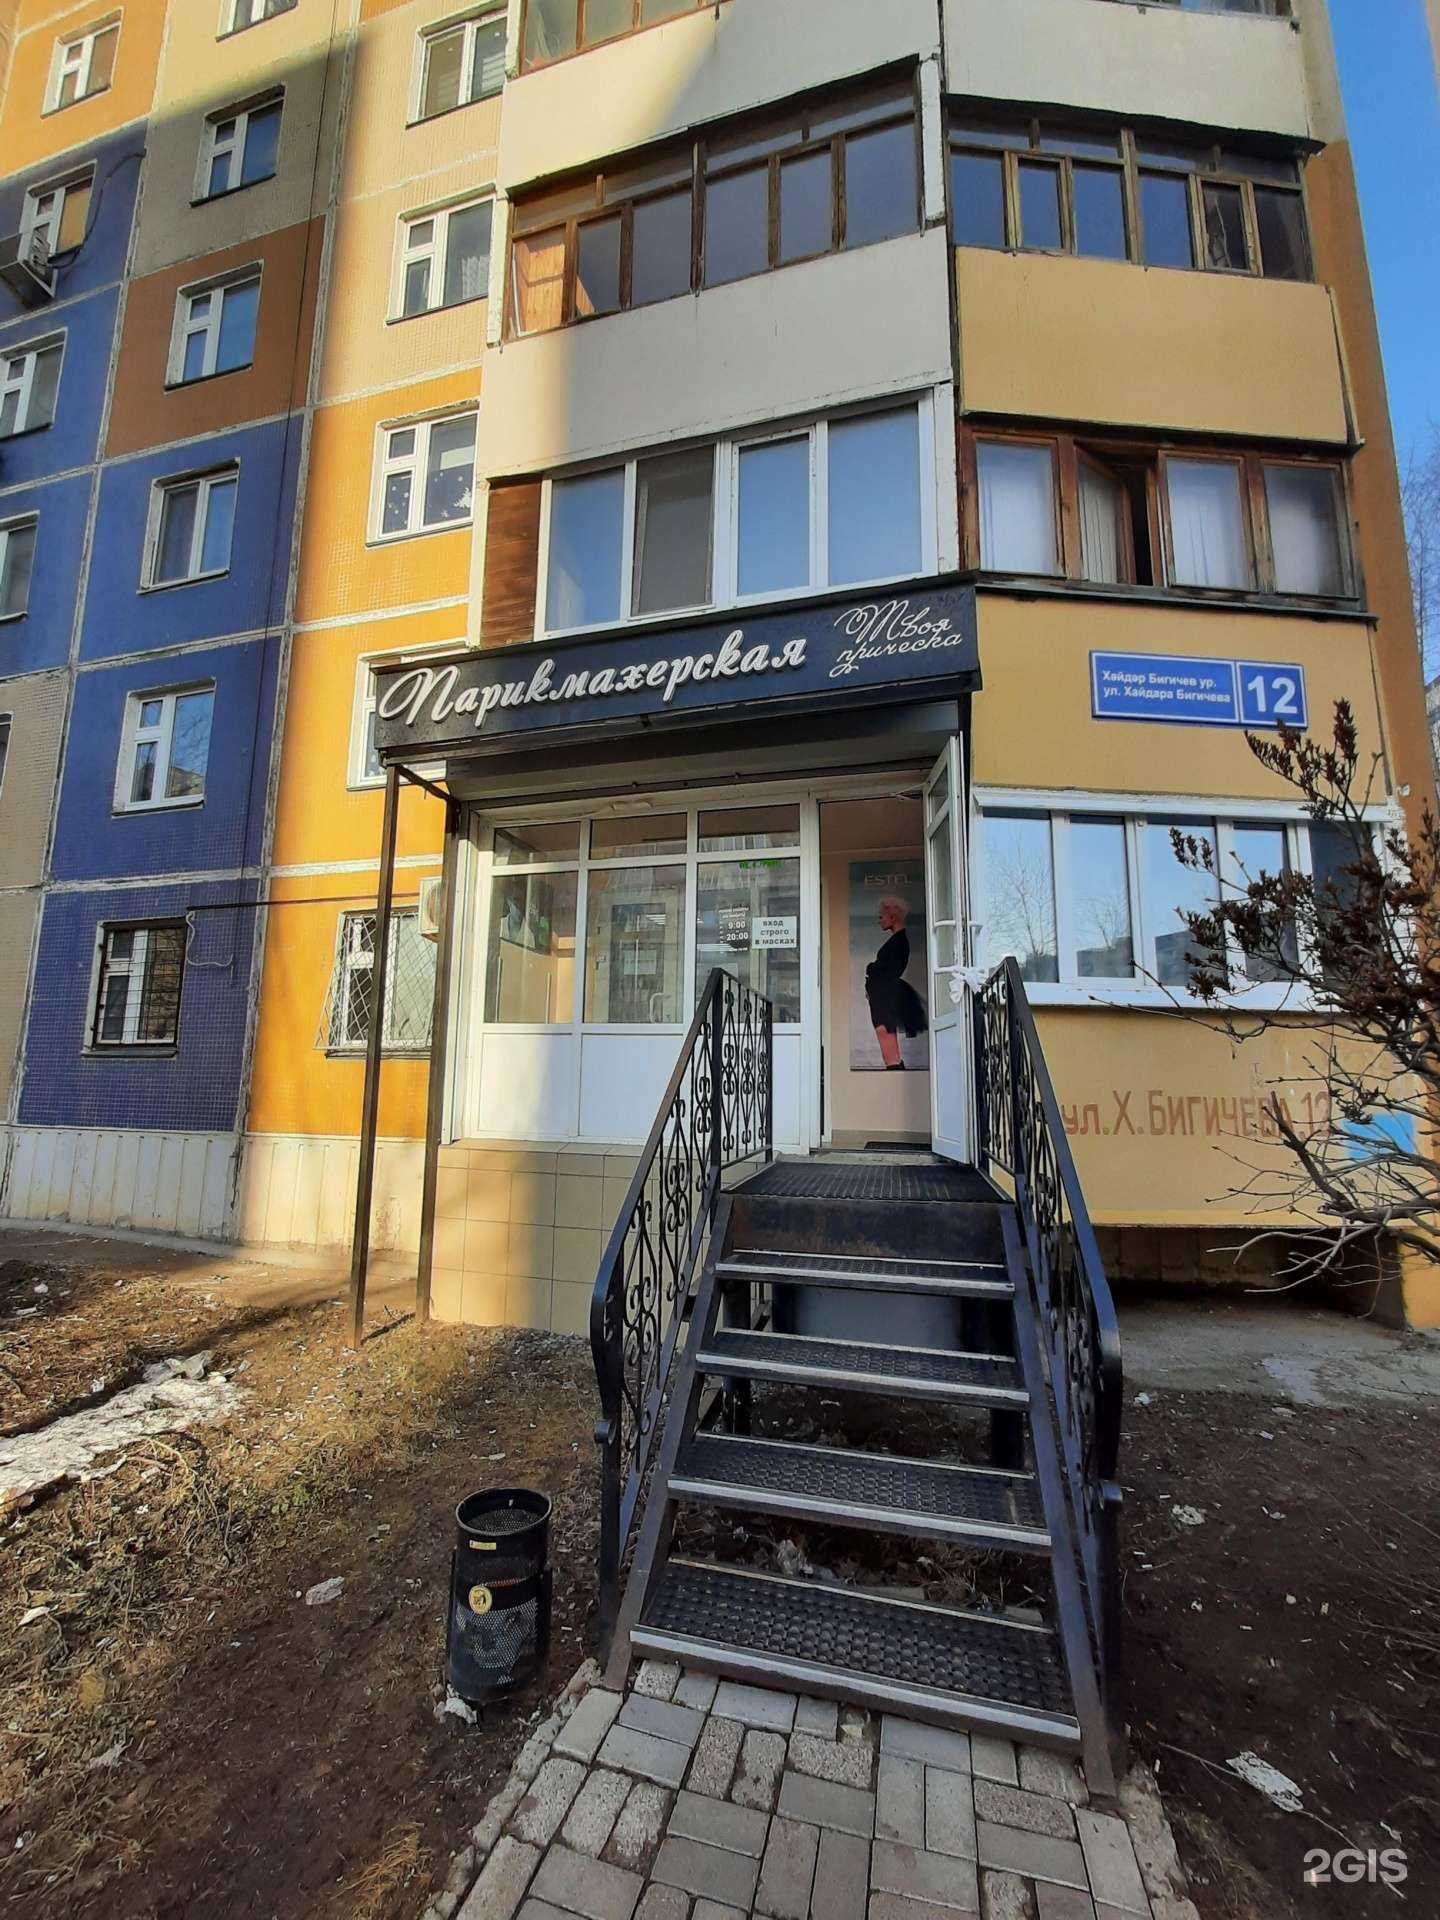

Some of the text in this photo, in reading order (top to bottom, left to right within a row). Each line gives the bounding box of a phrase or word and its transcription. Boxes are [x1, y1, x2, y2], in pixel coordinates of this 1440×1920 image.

[834, 600, 952, 643] Твоя
[829, 633, 962, 678] прическа
[379, 629, 806, 727] Парикмахерская
[1149, 673, 1197, 687] Бигичев
[1103, 686, 1231, 703] ул. Хайдара Бигичева
[1247, 675, 1298, 714] 12
[726, 932, 749, 941] 20:00
[760, 929, 789, 937] строго
